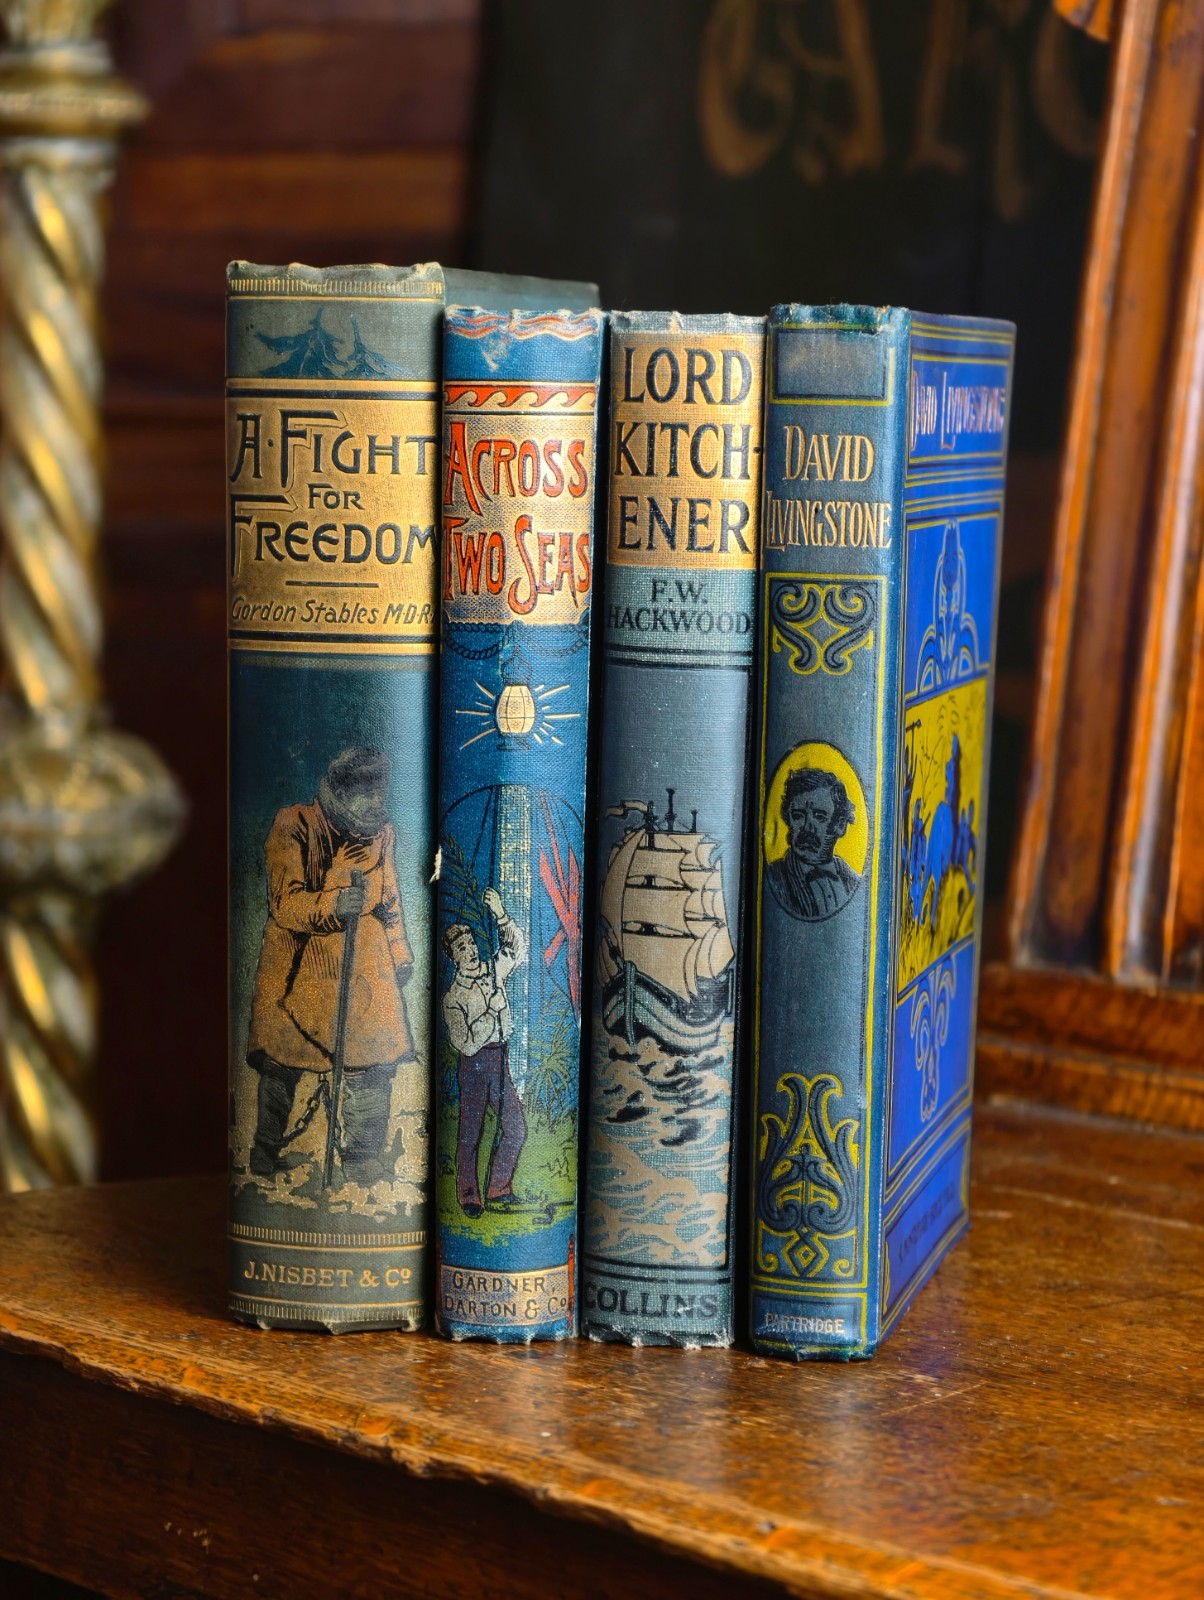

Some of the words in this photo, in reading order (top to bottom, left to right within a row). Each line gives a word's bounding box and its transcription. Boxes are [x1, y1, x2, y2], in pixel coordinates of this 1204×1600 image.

[623, 346, 753, 405] LORD
[230, 413, 263, 483] A
[279, 409, 438, 490] FIGHT
[444, 421, 589, 516] ACROSS
[782, 425, 876, 483] DAVID
[307, 483, 364, 511] FOR
[617, 495, 752, 555] ENER
[766, 490, 893, 551] LIVINGSTONE
[230, 494, 438, 580] FREEDOM
[444, 516, 508, 601] TWO
[508, 514, 591, 615] SEAS
[230, 596, 298, 622] Gordon
[301, 599, 380, 624] Stables
[607, 604, 751, 635] HACKWOOD
[359, 1269, 380, 1288] &
[443, 1294, 518, 1318] DARTON
[524, 1298, 541, 1320] &
[583, 1281, 720, 1320] COLLINS
[764, 1311, 846, 1335] PARTRIDGE
